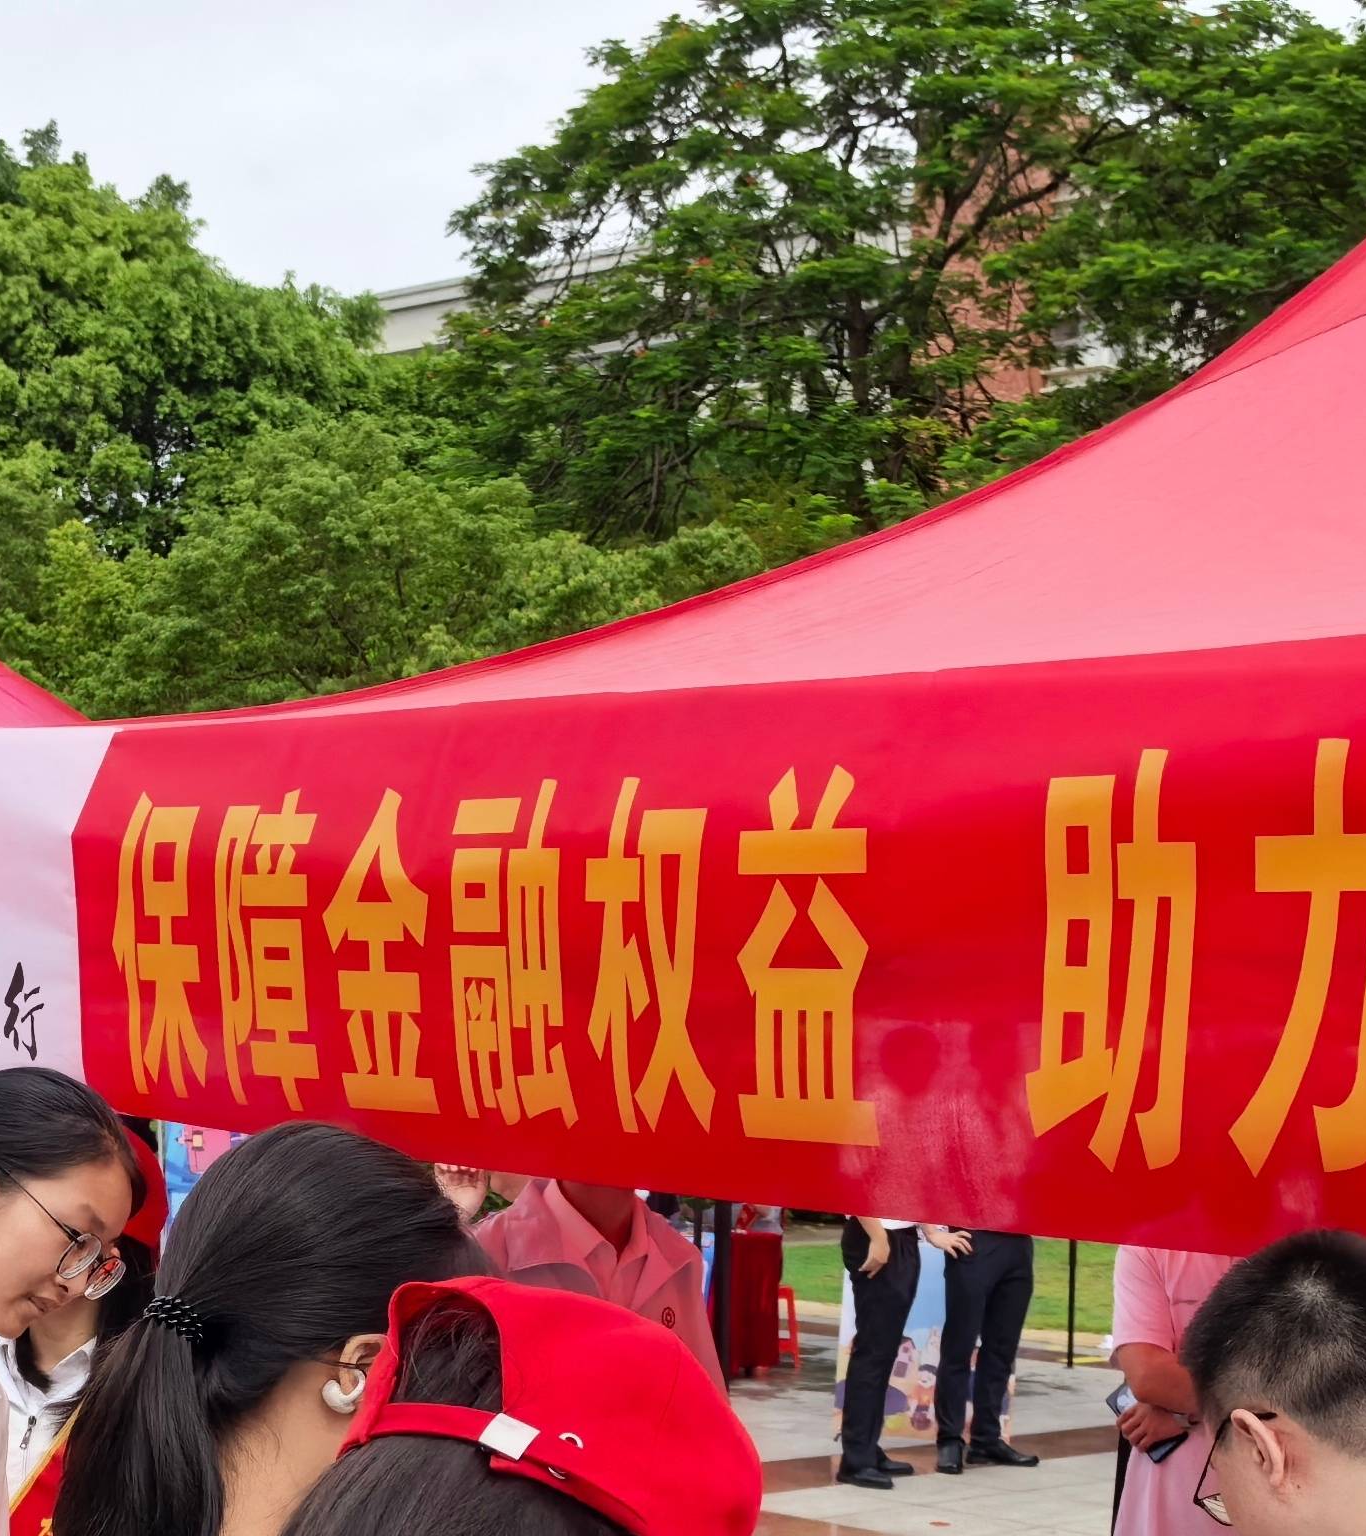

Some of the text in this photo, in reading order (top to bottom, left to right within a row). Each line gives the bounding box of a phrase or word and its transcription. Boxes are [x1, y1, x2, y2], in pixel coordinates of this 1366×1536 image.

[112, 765, 879, 1146] 保障金融权益
